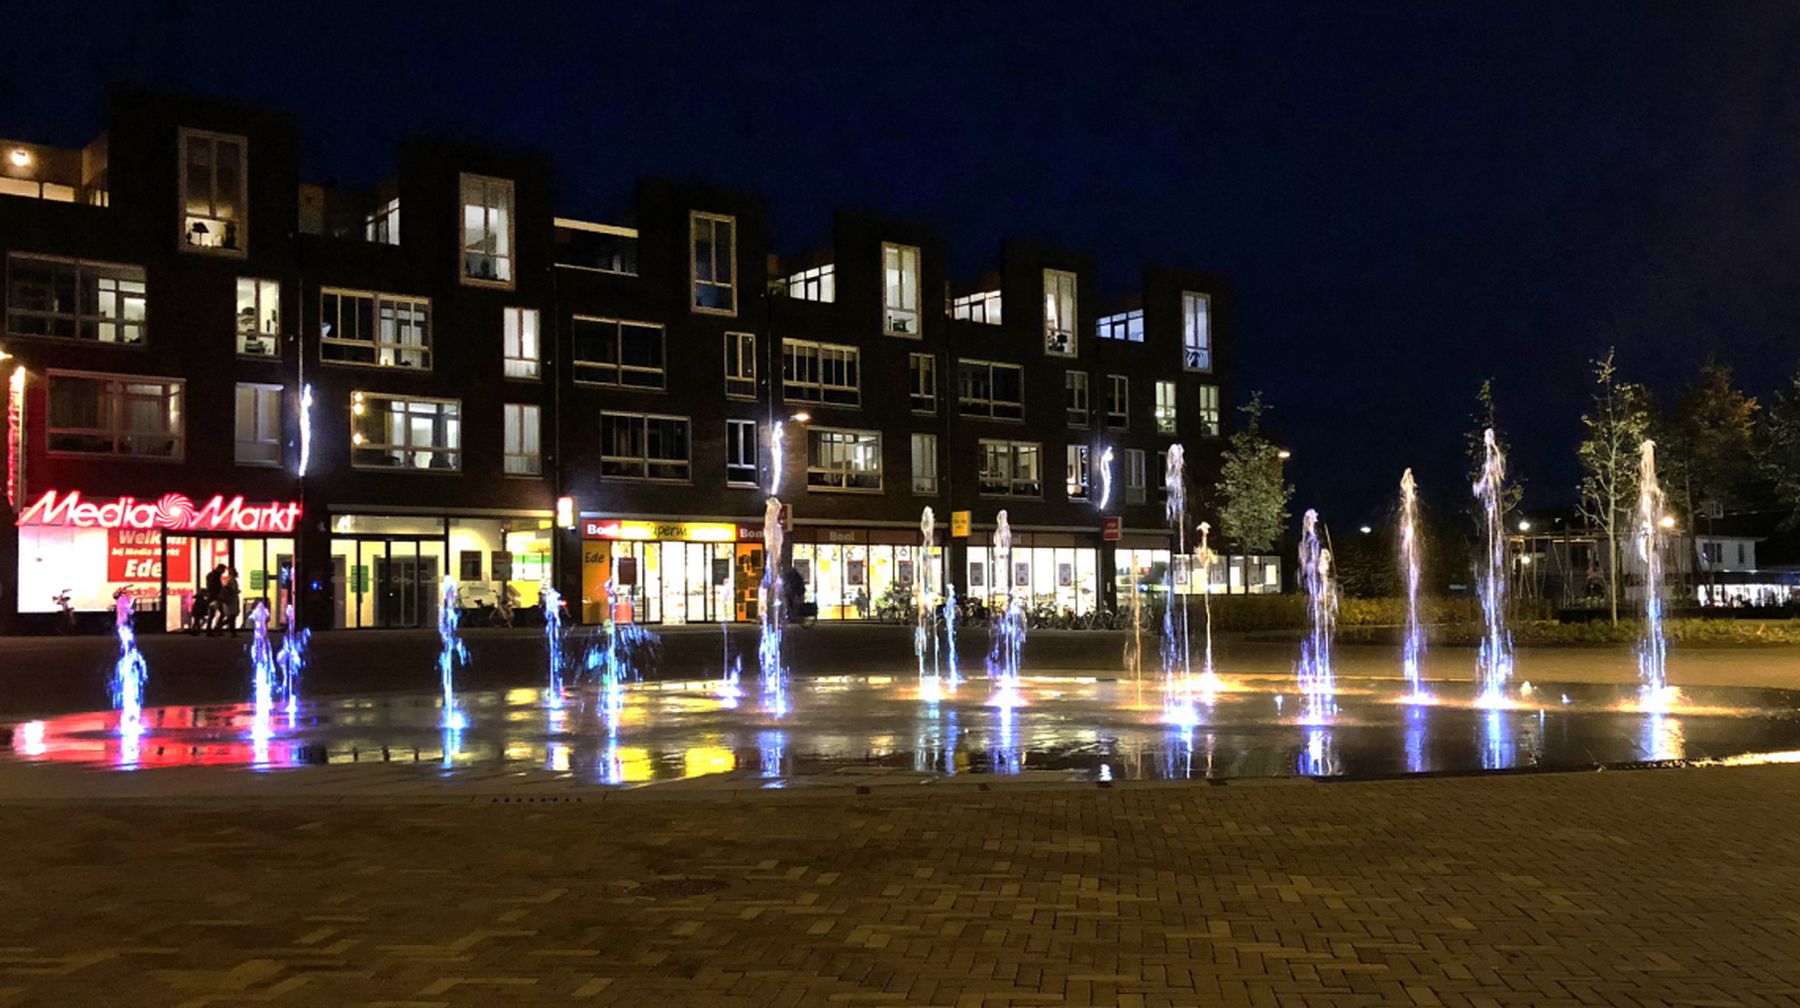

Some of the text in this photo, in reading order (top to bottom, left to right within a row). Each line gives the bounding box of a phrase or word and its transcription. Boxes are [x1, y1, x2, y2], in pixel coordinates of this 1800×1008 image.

[18, 490, 301, 531] Media Markt
[153, 548, 180, 556] Mrkt
[585, 552, 605, 564] Ede
[124, 558, 162, 578] Ede
